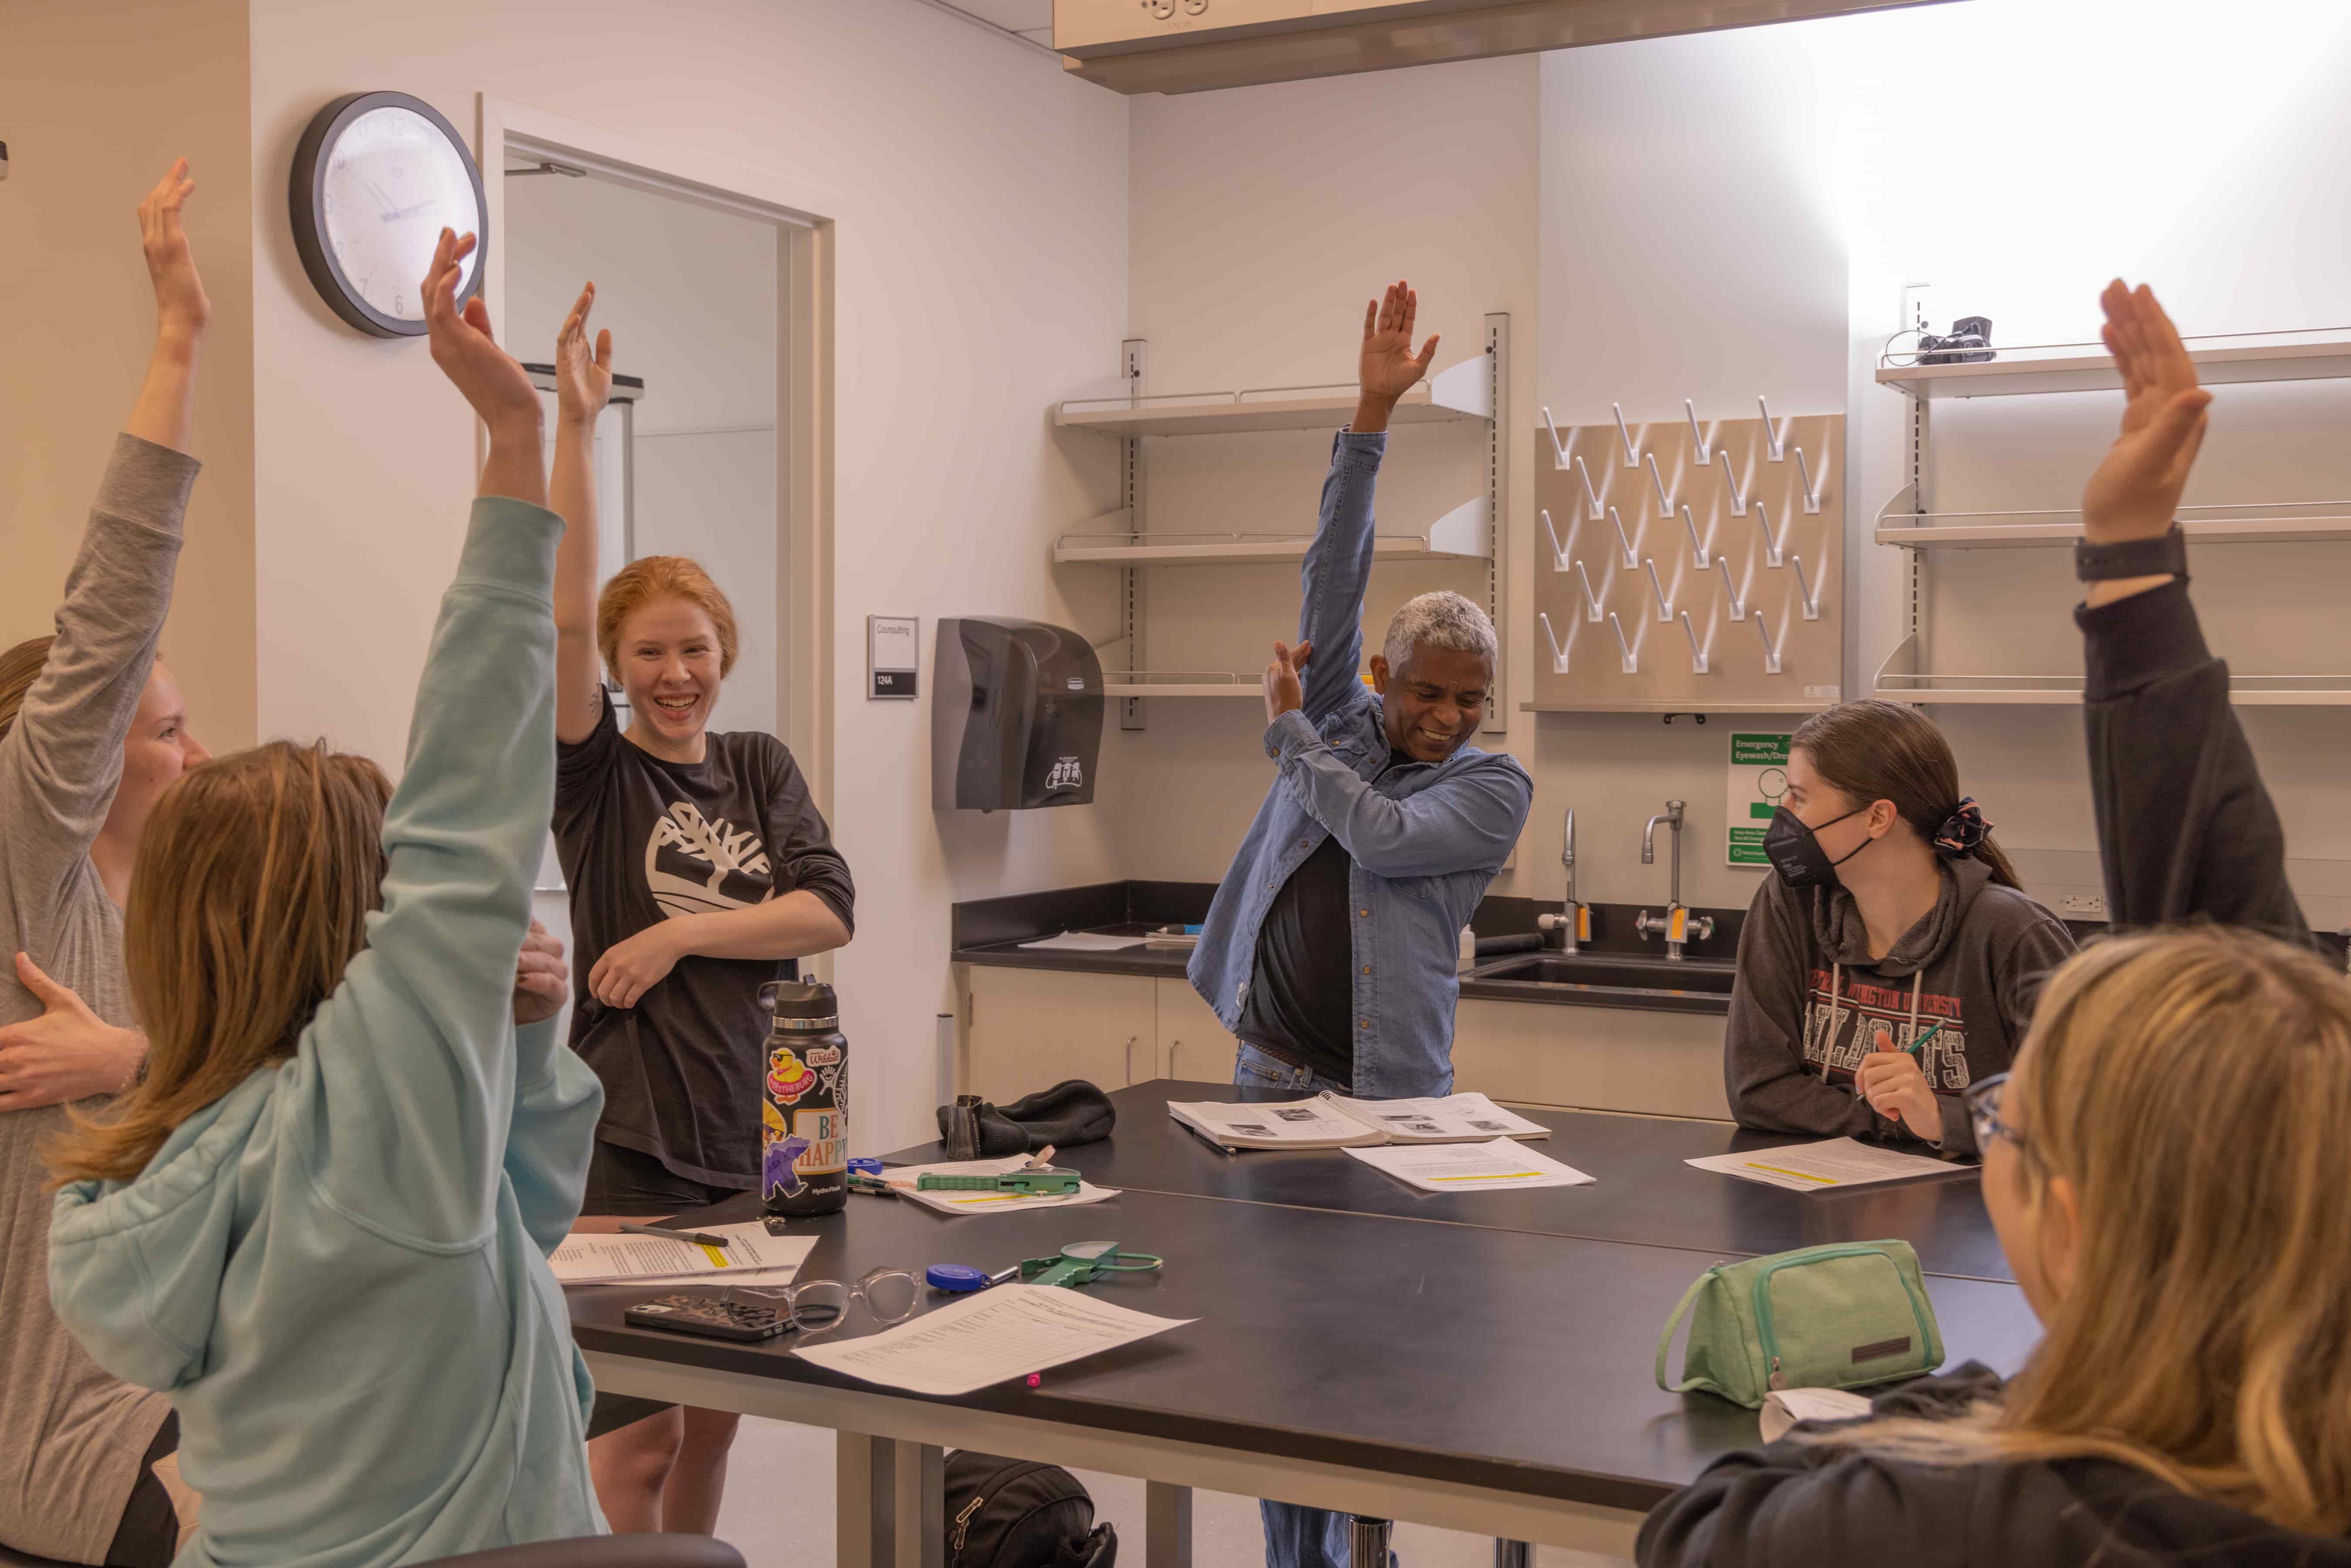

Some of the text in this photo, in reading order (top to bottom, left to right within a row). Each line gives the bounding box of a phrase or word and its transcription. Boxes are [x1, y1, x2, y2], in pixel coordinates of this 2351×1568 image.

[359, 276, 368, 296] 7
[395, 293, 404, 315] 6
[877, 676, 893, 685] 124A
[1735, 740, 1778, 750] Emergency
[1735, 751, 1789, 761] Eyewash/Dre
[1847, 983, 1900, 1009] INGTON
[1903, 992, 1961, 1017] UIVERSY
[810, 1052, 839, 1063] Wildcat
[819, 1114, 838, 1139] BE
[798, 1138, 846, 1166] HAPPY
